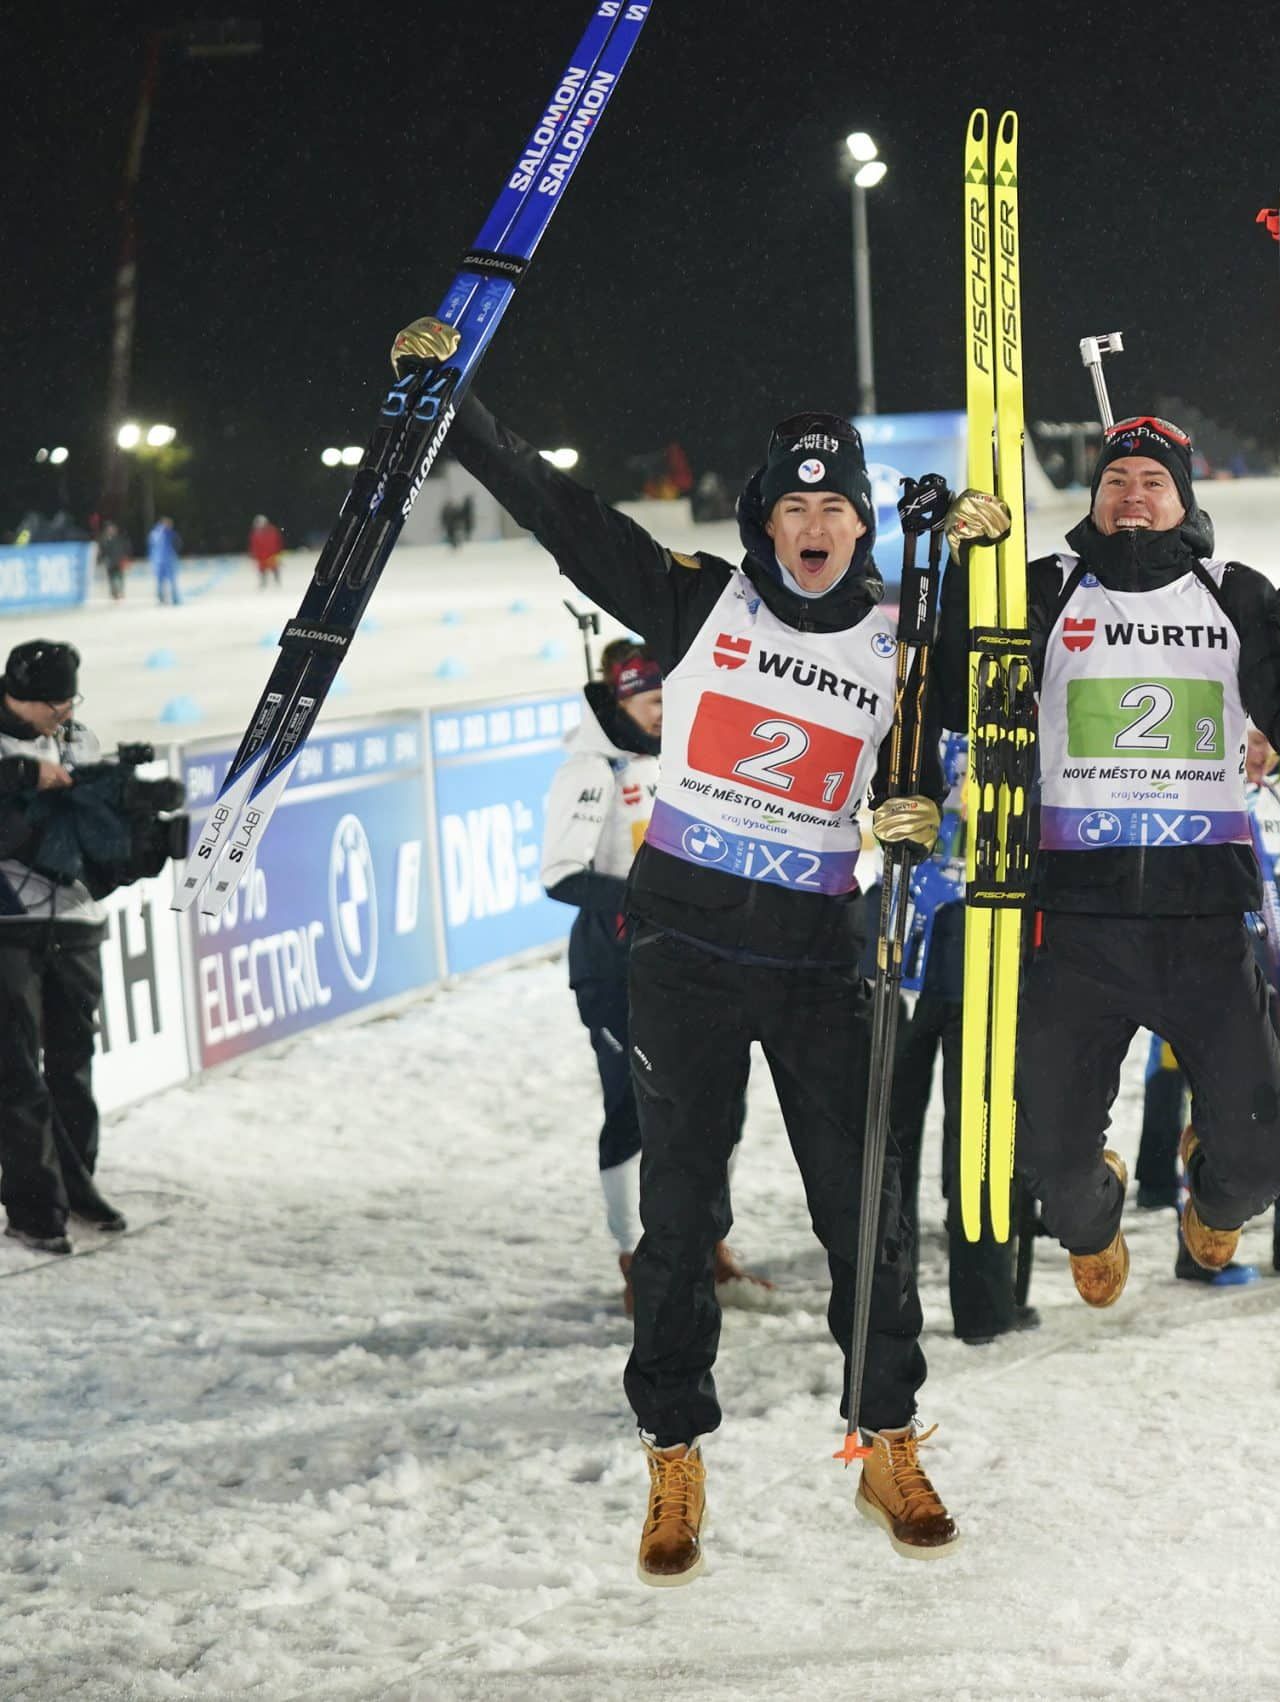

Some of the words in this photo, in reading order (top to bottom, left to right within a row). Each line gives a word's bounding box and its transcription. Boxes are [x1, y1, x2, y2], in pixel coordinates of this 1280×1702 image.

[507, 66, 587, 193] SALOMON
[538, 70, 615, 197] SALOMON
[463, 255, 523, 275] SALOMON
[970, 197, 989, 375] FISCHER
[999, 199, 1018, 377] FISCHER
[401, 403, 456, 519] SALOMON
[286, 627, 347, 646] SALOMON
[1104, 622, 1229, 650] WÜRTH
[758, 650, 880, 717] WÜRTH
[1113, 683, 1174, 750] 2
[1195, 718, 1216, 752] 2
[680, 777, 713, 798] NOVÉ
[713, 786, 763, 810] MĚSTO
[765, 802, 784, 818] NA
[733, 718, 809, 791] 2
[822, 771, 845, 803] 1
[1063, 766, 1097, 779] NOVÉ
[1099, 766, 1148, 780] MĚSTO
[1151, 769, 1171, 780] NA
[1175, 769, 1226, 782] MORAVĚ
[441, 803, 518, 927] DKB
[744, 842, 822, 887] iX2
[202, 920, 332, 1044] ELECTRIC
